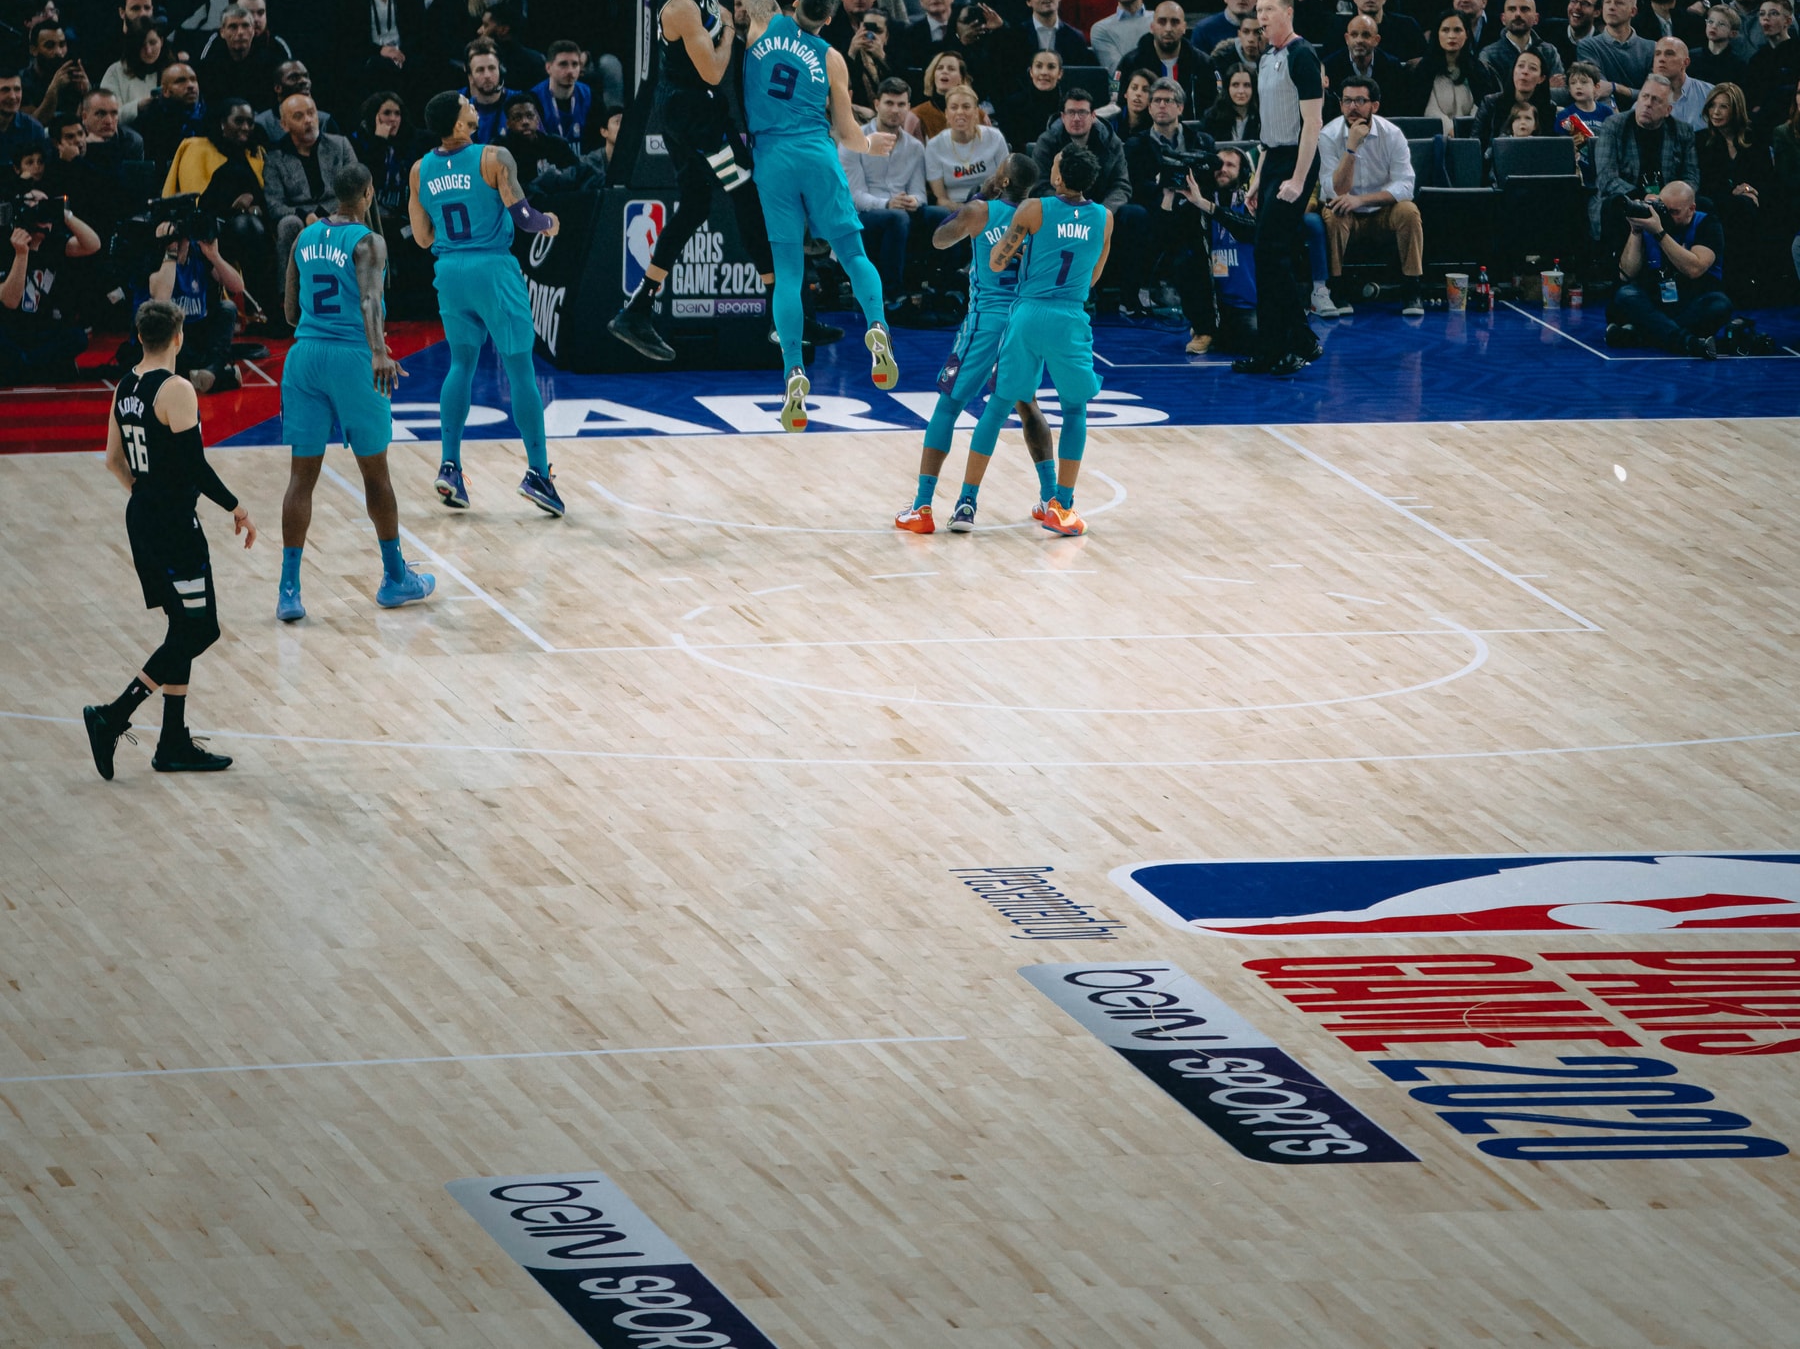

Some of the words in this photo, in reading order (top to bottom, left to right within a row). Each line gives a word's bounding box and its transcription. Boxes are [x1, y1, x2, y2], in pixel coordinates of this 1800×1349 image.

[751, 35, 825, 83] HERNANGÓMEZ
[767, 63, 799, 101] 9
[427, 173, 472, 196] BRIDGES
[953, 160, 987, 177] PARIS
[440, 202, 472, 242] 0
[1057, 223, 1092, 242] MONK
[681, 231, 724, 264] ARIS
[672, 263, 717, 296] GAME
[1055, 250, 1075, 287] 1
[312, 274, 341, 315] 2
[717, 302, 762, 314] SPORTS
[1241, 953, 1645, 1053] GAME
[1168, 1056, 1369, 1157] SPORTS
[1368, 1055, 1790, 1161] 2020
[578, 1274, 738, 1349] SPOR
